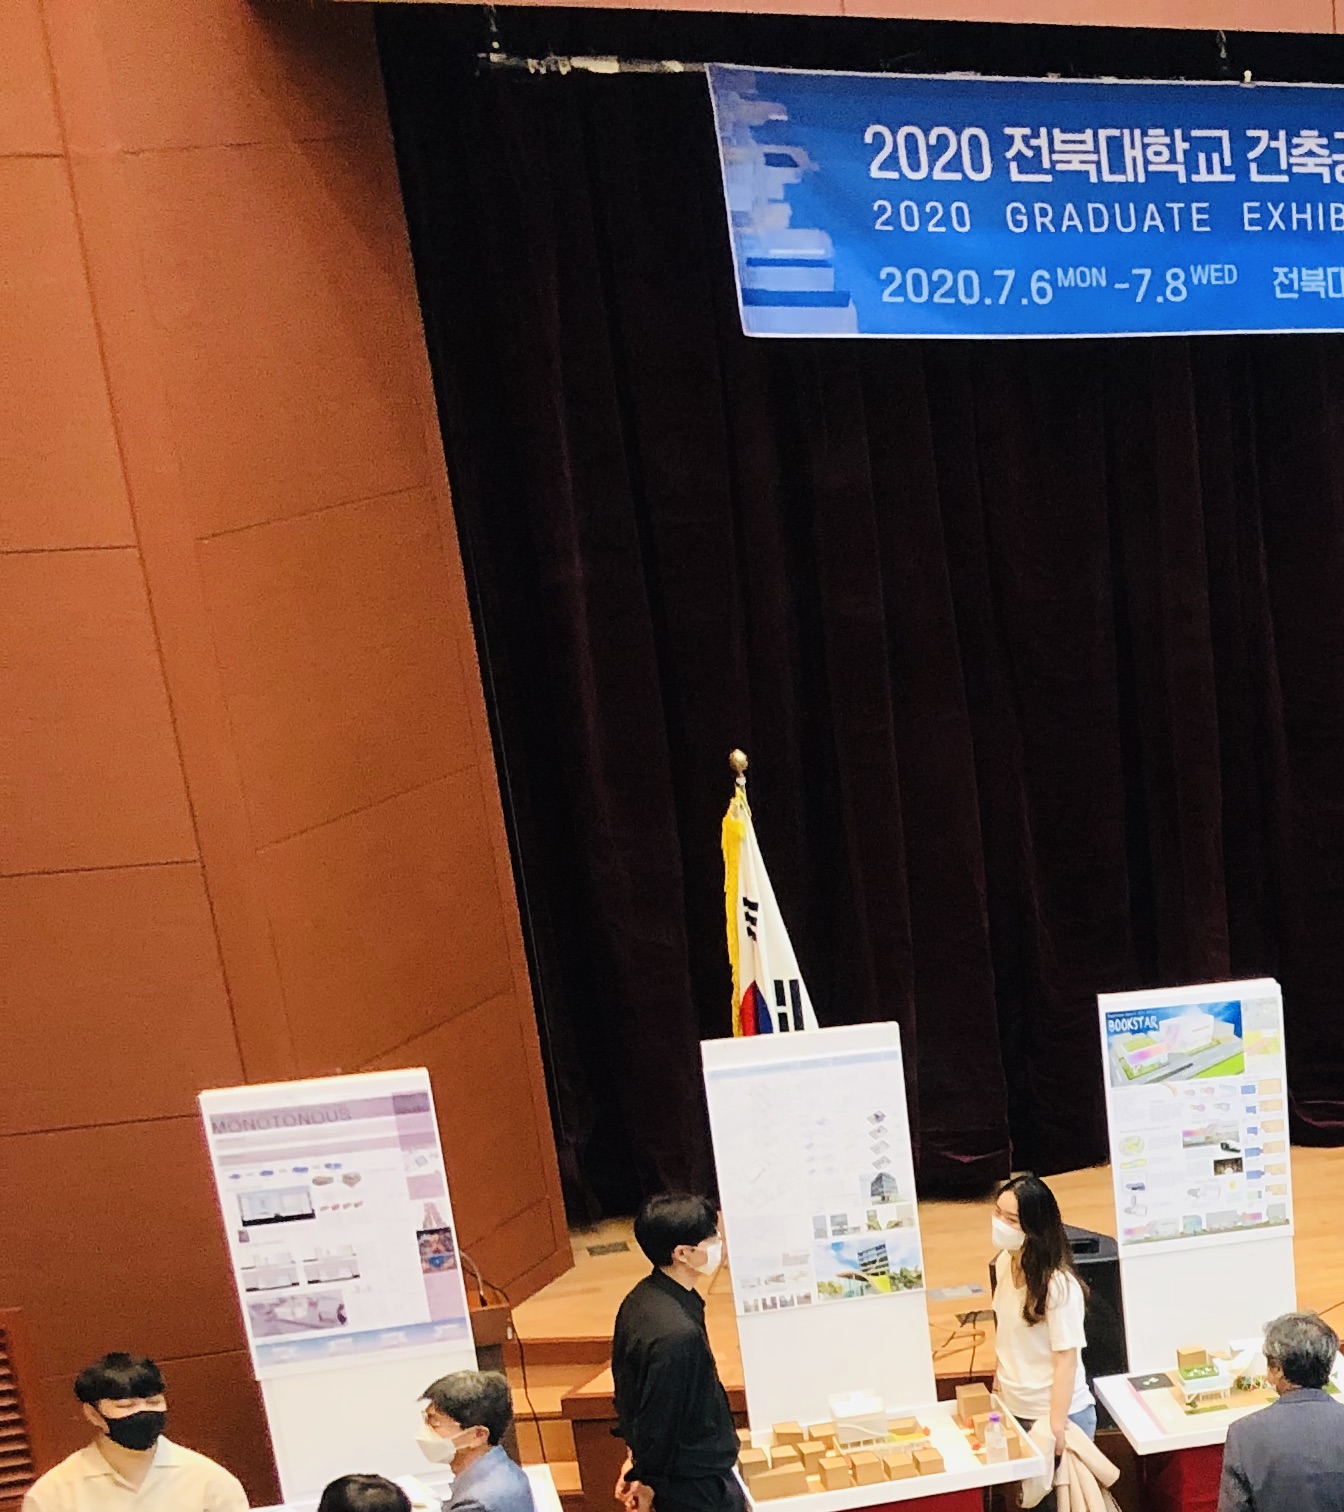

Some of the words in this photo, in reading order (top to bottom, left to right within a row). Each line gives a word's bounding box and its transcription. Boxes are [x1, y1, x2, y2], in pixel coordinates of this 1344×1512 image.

[864, 125, 992, 181] 2020
[1004, 127, 1236, 184] 전북대학교
[874, 199, 971, 232] 2020
[1006, 202, 1211, 233] GRADUATE
[1108, 1015, 1159, 1032] BOOKSTAR
[212, 1107, 352, 1134] MONOTONOUS
